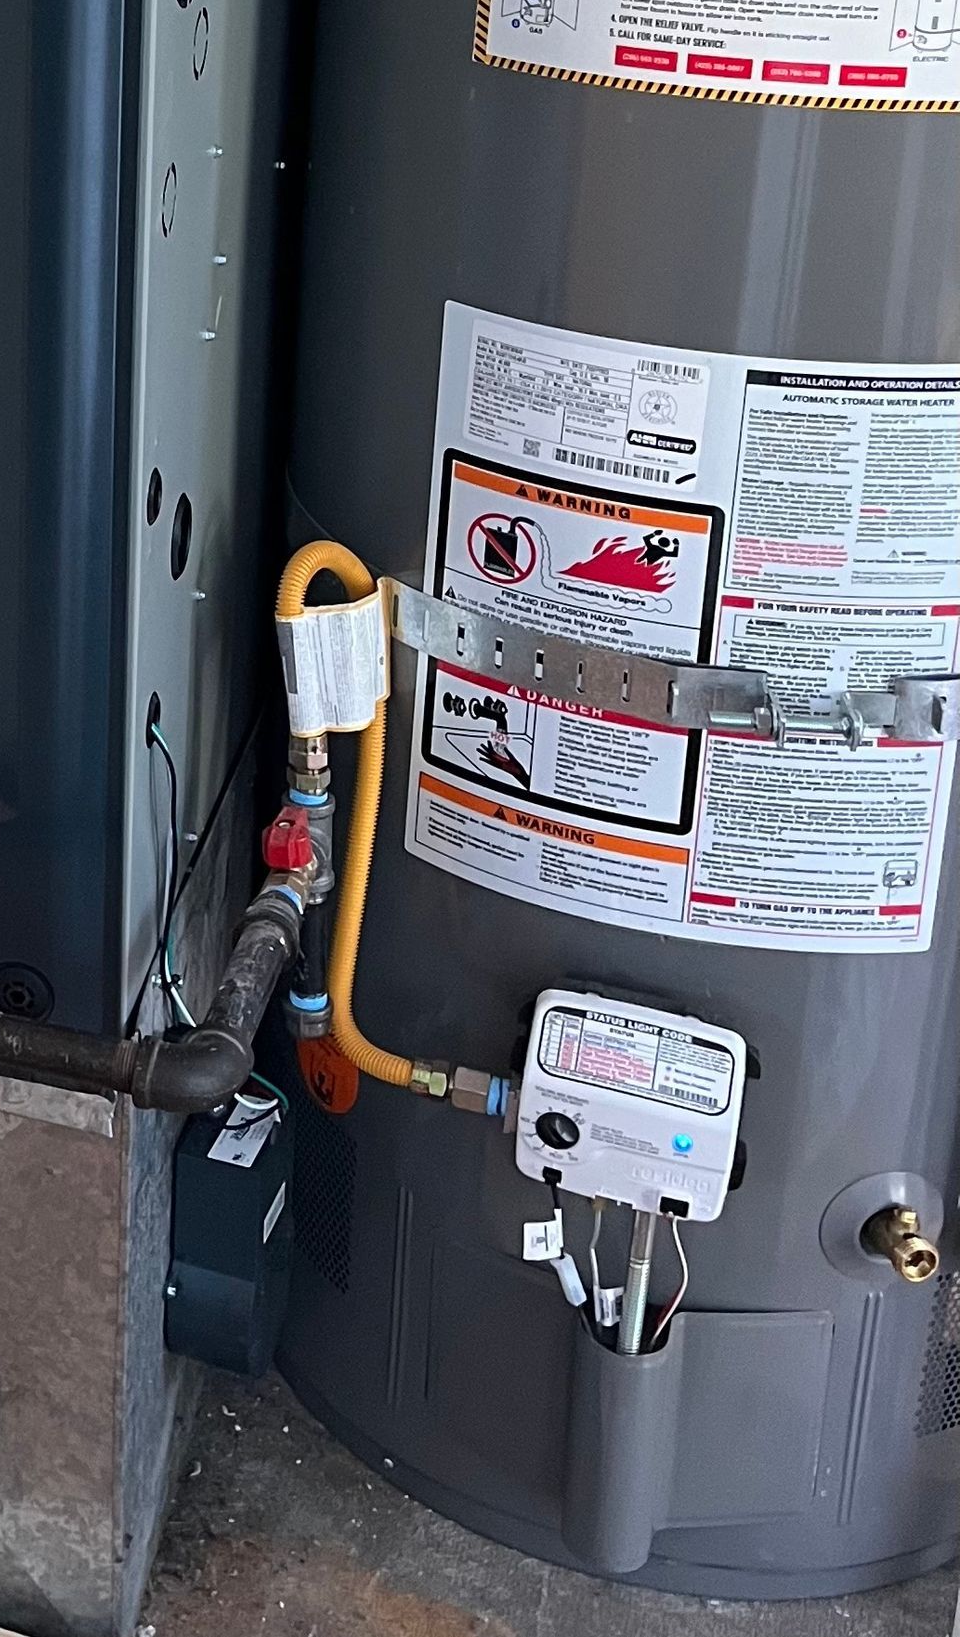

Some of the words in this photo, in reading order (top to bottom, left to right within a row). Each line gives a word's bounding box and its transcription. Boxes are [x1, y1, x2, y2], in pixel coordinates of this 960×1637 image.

[611, 14, 617, 23] 4.
[618, 15, 638, 25] OPEN
[640, 18, 653, 27] THE
[655, 19, 679, 30] RELIEF
[681, 22, 705, 32] VALVE.
[618, 30, 635, 40] CALL
[637, 32, 652, 41] FOR
[654, 34, 691, 46] SAME-DAY
[780, 376, 846, 387] INSTALLATION
[847, 380, 869, 388] AND
[870, 380, 923, 389] OPERATION
[782, 394, 838, 405] AUTOMATIC
[841, 397, 885, 406] STORAGE
[536, 488, 631, 519] WARNING
[458, 593, 467, 601] Do
[558, 582, 610, 600] Flammable
[612, 594, 646, 606] Vapors
[495, 597, 509, 606] Can
[511, 603, 532, 613] result
[543, 612, 571, 624] serious
[610, 627, 633, 636] death
[502, 590, 519, 600] FIRE
[521, 597, 538, 606] AND
[541, 602, 588, 619] EXPLOSION
[590, 612, 627, 626] HAZARD
[757, 603, 773, 611] FOR
[776, 603, 797, 612] YOUR
[799, 605, 829, 614] SAFETY
[831, 607, 852, 615] READ
[526, 690, 603, 718] DANGER
[491, 732, 510, 744] HOT
[515, 813, 595, 845] WARNING
[586, 1012, 626, 1028] STATUS
[627, 1021, 660, 1036] LIGHT
[661, 1027, 693, 1043] CODE
